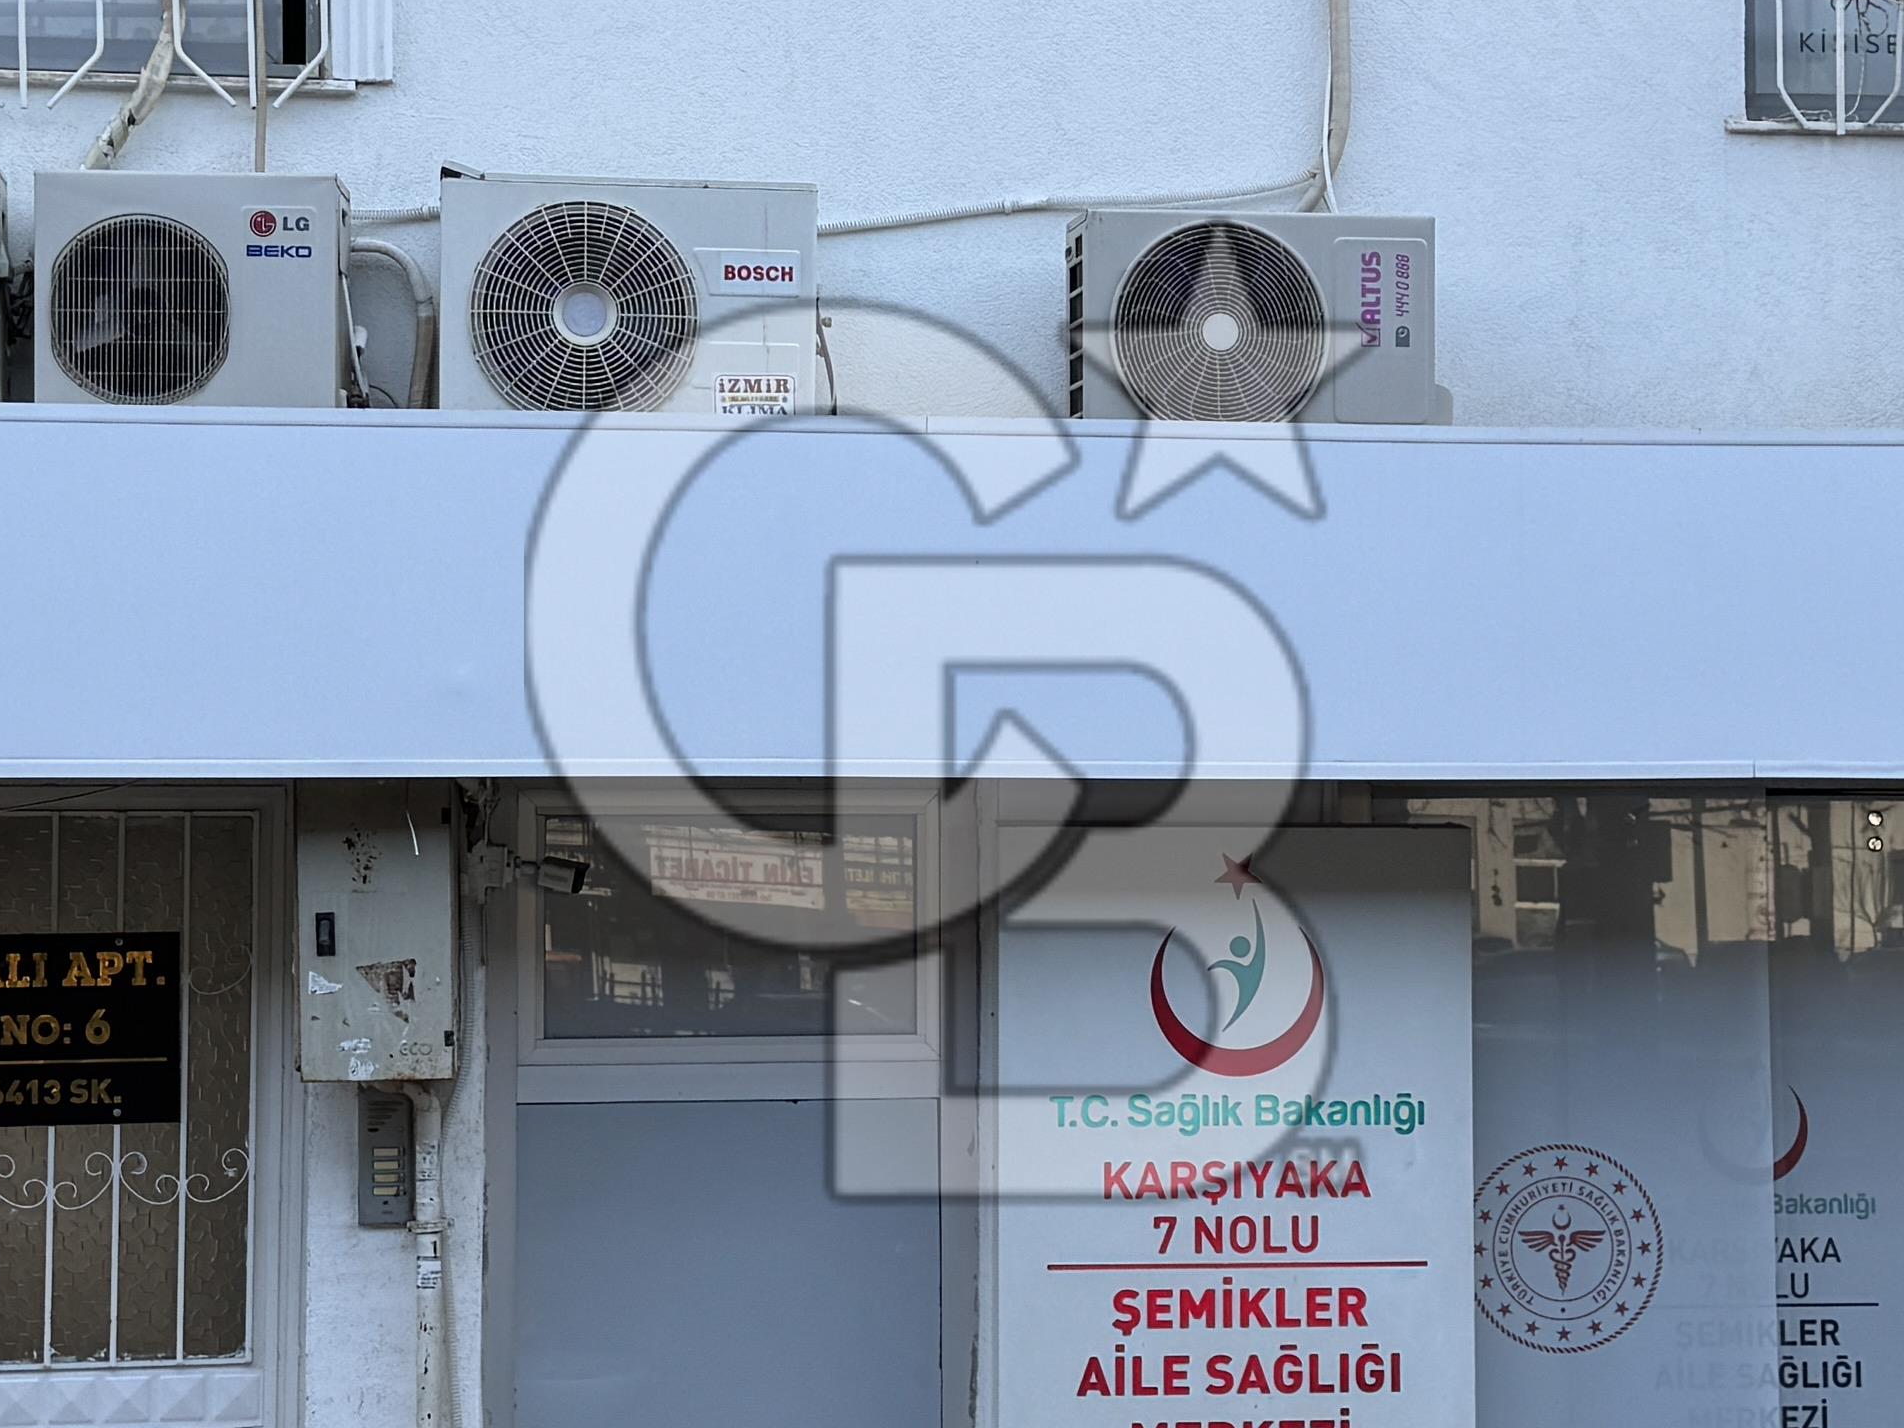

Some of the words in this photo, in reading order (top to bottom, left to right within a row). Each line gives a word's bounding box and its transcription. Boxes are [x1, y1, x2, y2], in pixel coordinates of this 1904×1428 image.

[283, 216, 310, 232] LG
[246, 245, 312, 258] BEKO
[724, 265, 794, 282] BOSCH
[1361, 251, 1381, 325] ALTUS
[62, 950, 166, 987] APT.
[0, 1014, 72, 1045] NO:
[85, 1009, 111, 1045] 6
[69, 1078, 123, 1105] SK.
[1049, 1095, 1119, 1129] T.C.
[1127, 1093, 1244, 1137] Sağlık
[1254, 1092, 1425, 1136] Bakanlığı
[1103, 1160, 1371, 1205] KARŞIYAKA
[1153, 1216, 1178, 1254] 7
[1194, 1215, 1320, 1254] NOLU
[1112, 1277, 1368, 1335] ŞEMİKLER
[1076, 1344, 1191, 1397] AİLE
[1204, 1343, 1402, 1395] SAĞLIĞI
